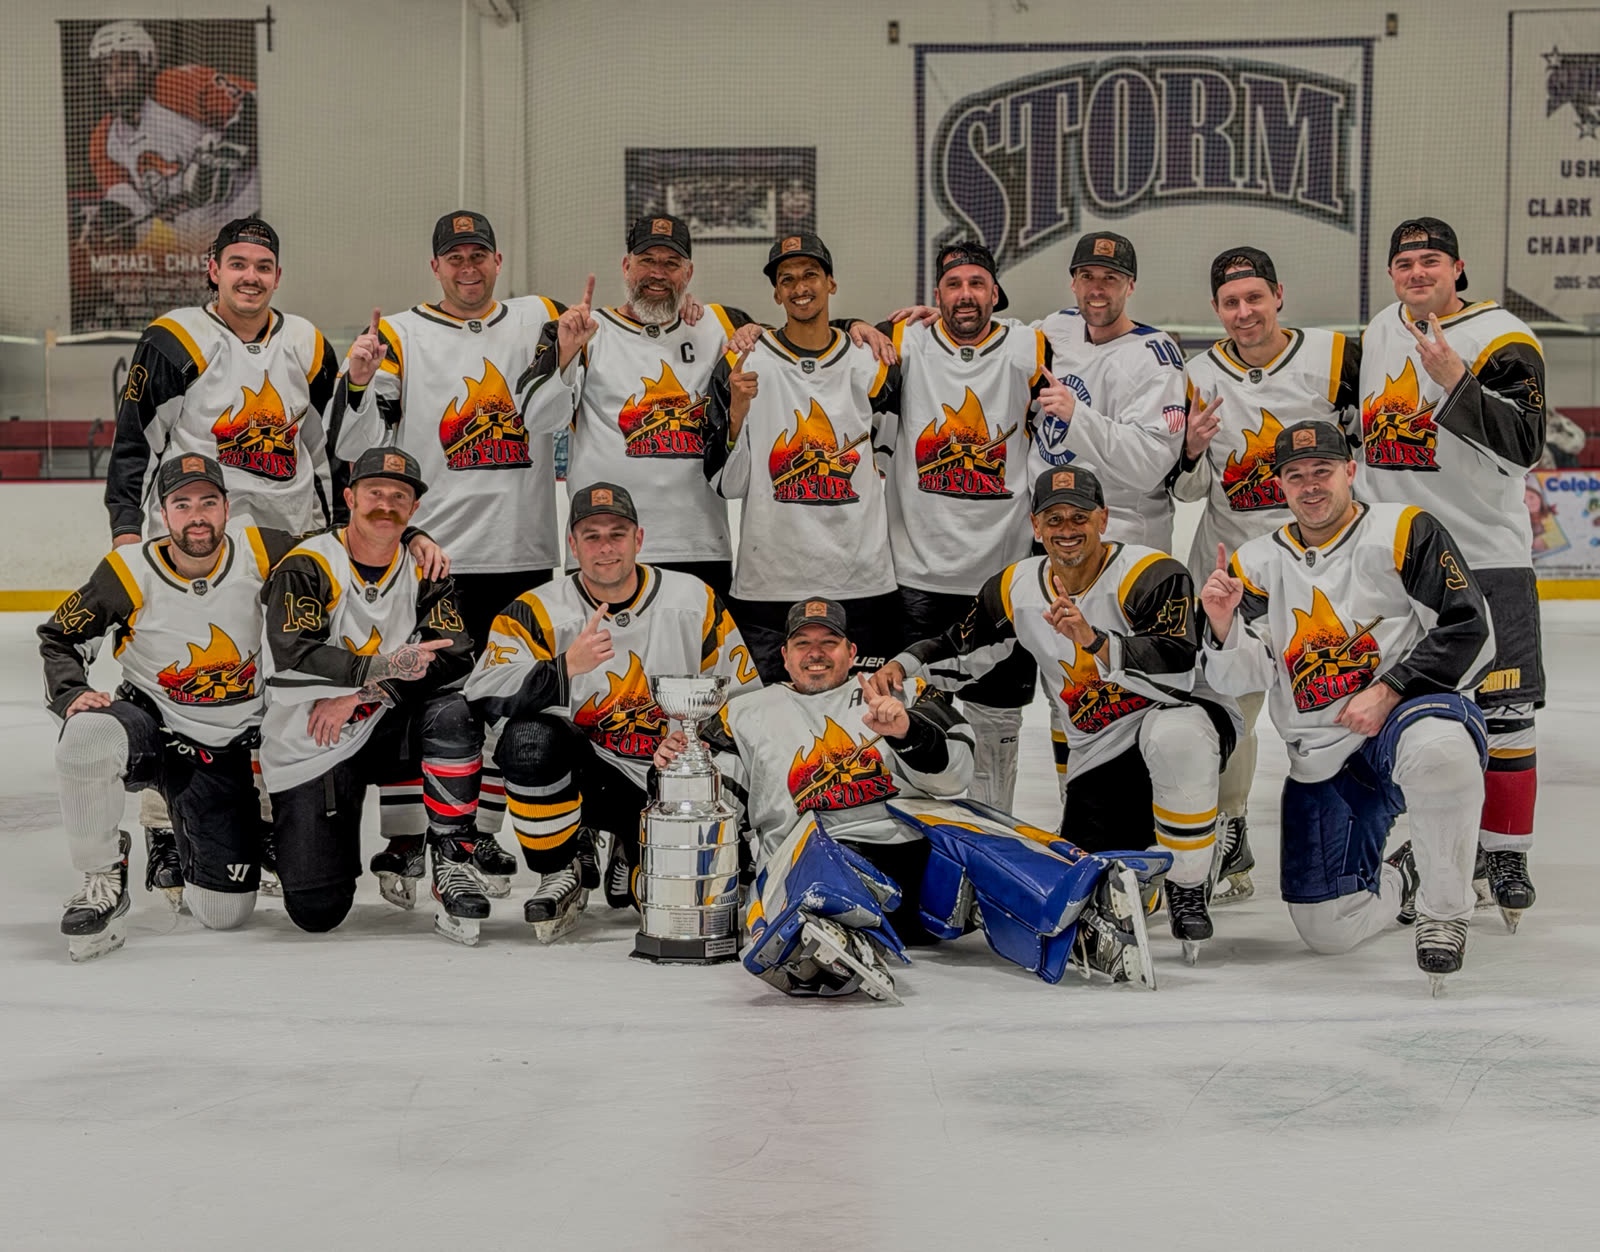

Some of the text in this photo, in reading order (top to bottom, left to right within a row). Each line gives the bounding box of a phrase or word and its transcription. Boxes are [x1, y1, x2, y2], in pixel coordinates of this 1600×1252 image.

[940, 64, 1350, 266] STORM
[1527, 198, 1592, 217] CLARK
[91, 255, 157, 272] MICHAEL
[680, 341, 695, 363] C
[1145, 339, 1184, 371] 10
[245, 450, 297, 478] FURY
[473, 437, 530, 464] FURY
[798, 475, 858, 500] FURY
[942, 467, 1012, 494] FURY
[1546, 476, 1600, 491] Celeb
[1440, 550, 1468, 590] 3
[283, 592, 322, 632] 13
[847, 687, 864, 710] A
[821, 775, 898, 811] FURY
